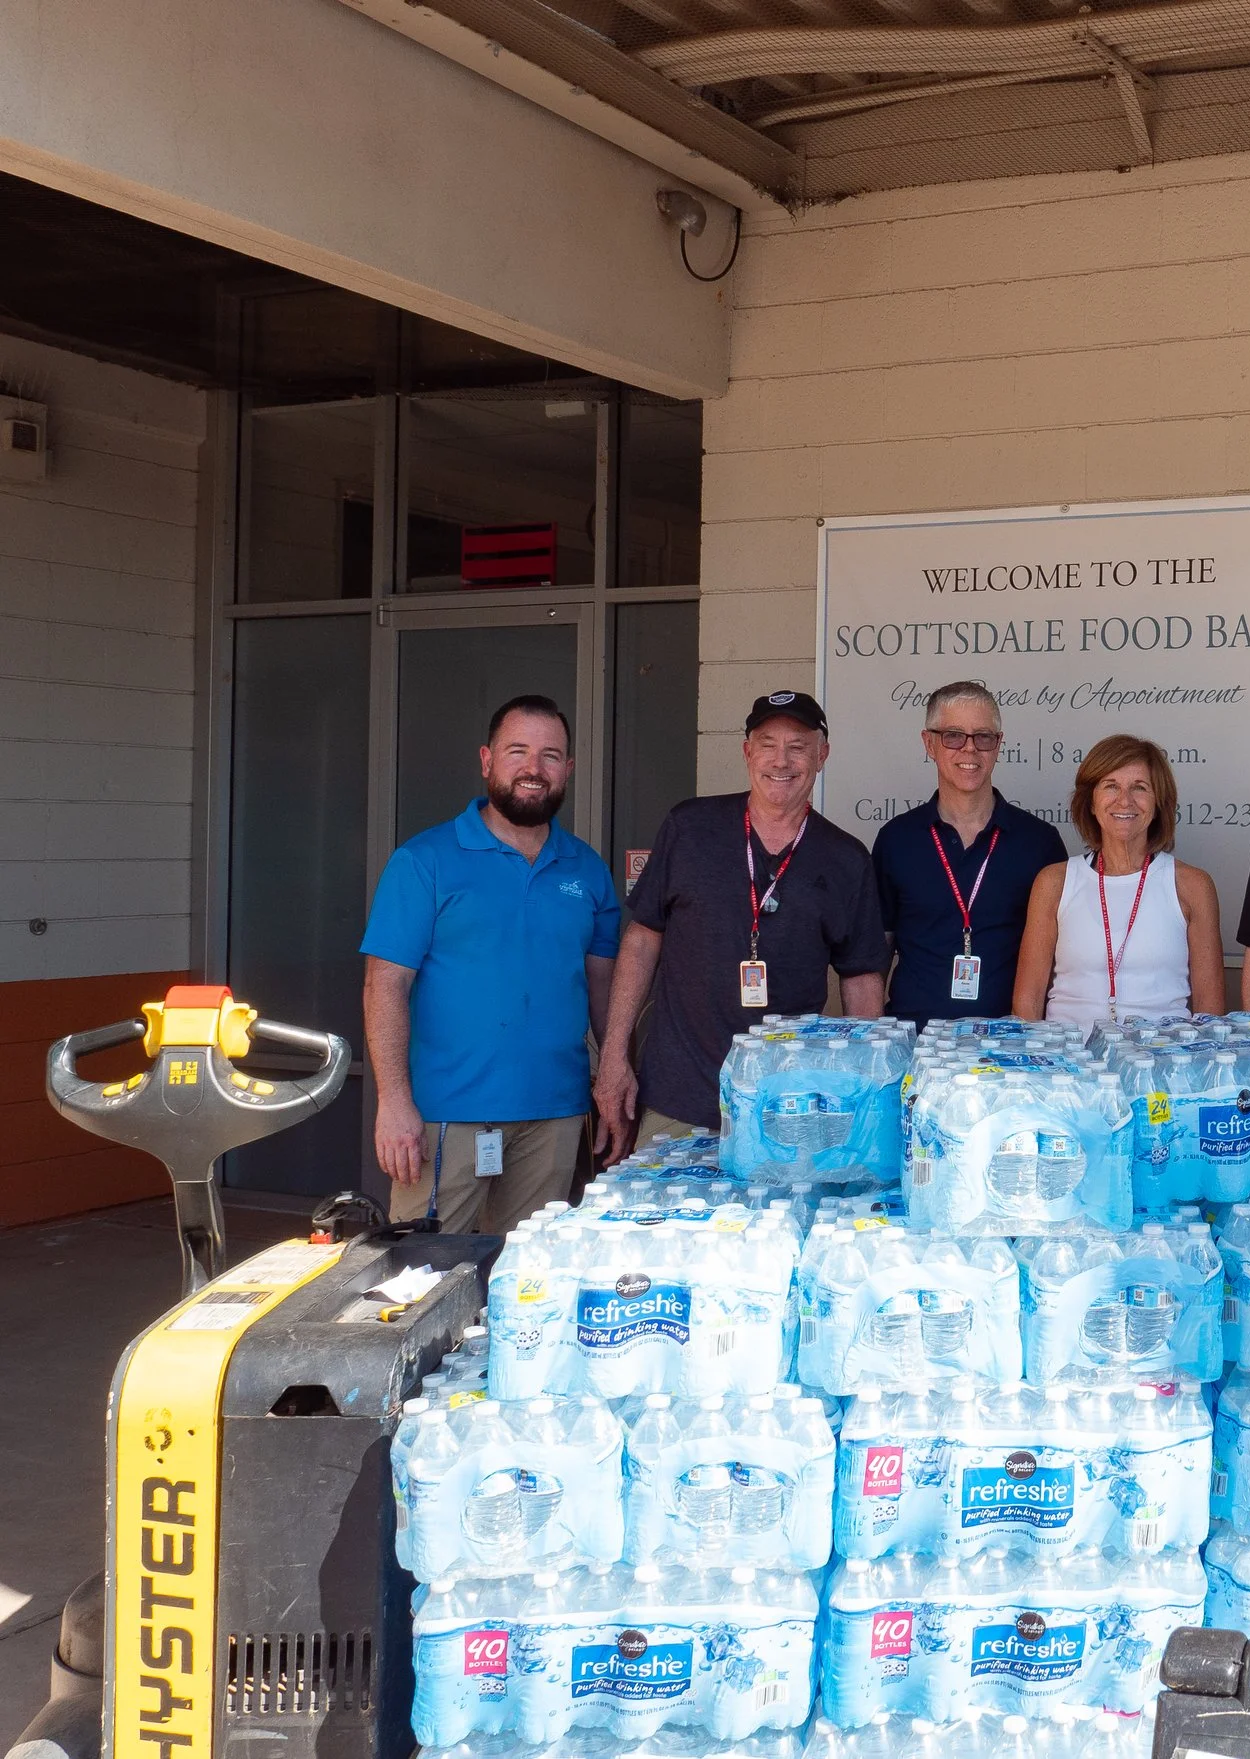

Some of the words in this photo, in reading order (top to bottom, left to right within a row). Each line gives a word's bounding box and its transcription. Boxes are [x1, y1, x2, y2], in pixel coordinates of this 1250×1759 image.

[922, 563, 1081, 594] WELCOME
[1091, 560, 1138, 588] TO
[1147, 557, 1216, 585] THE
[835, 619, 1065, 658] SCOTTSDALE
[1079, 615, 1192, 652] FOOD
[891, 680, 932, 711] Foo
[1036, 684, 1067, 713] by
[1071, 676, 1250, 712] Appointment
[1051, 742, 1064, 763] 8
[855, 798, 895, 822] Call
[1151, 1099, 1168, 1115] 24
[1201, 1141, 1233, 1153] purified
[521, 1279, 545, 1294] 24
[578, 1330, 612, 1343] purified
[614, 1321, 659, 1342] drinking
[661, 1324, 689, 1340] water
[868, 1454, 900, 1479] 40
[868, 1479, 897, 1487] BOTTLES
[965, 1508, 1000, 1523] purified
[1004, 1507, 1041, 1522] drinking
[1043, 1511, 1070, 1521] water
[140, 1477, 197, 1759] HYSTER
[874, 1619, 910, 1642] 40
[467, 1638, 505, 1660] 40
[874, 1641, 907, 1650] BOTTLES
[974, 1660, 1010, 1673] purified
[1014, 1662, 1050, 1675] drinking
[1052, 1663, 1078, 1673] water
[575, 1679, 613, 1694] purified
[615, 1680, 653, 1694] drinking
[657, 1682, 686, 1693] water
